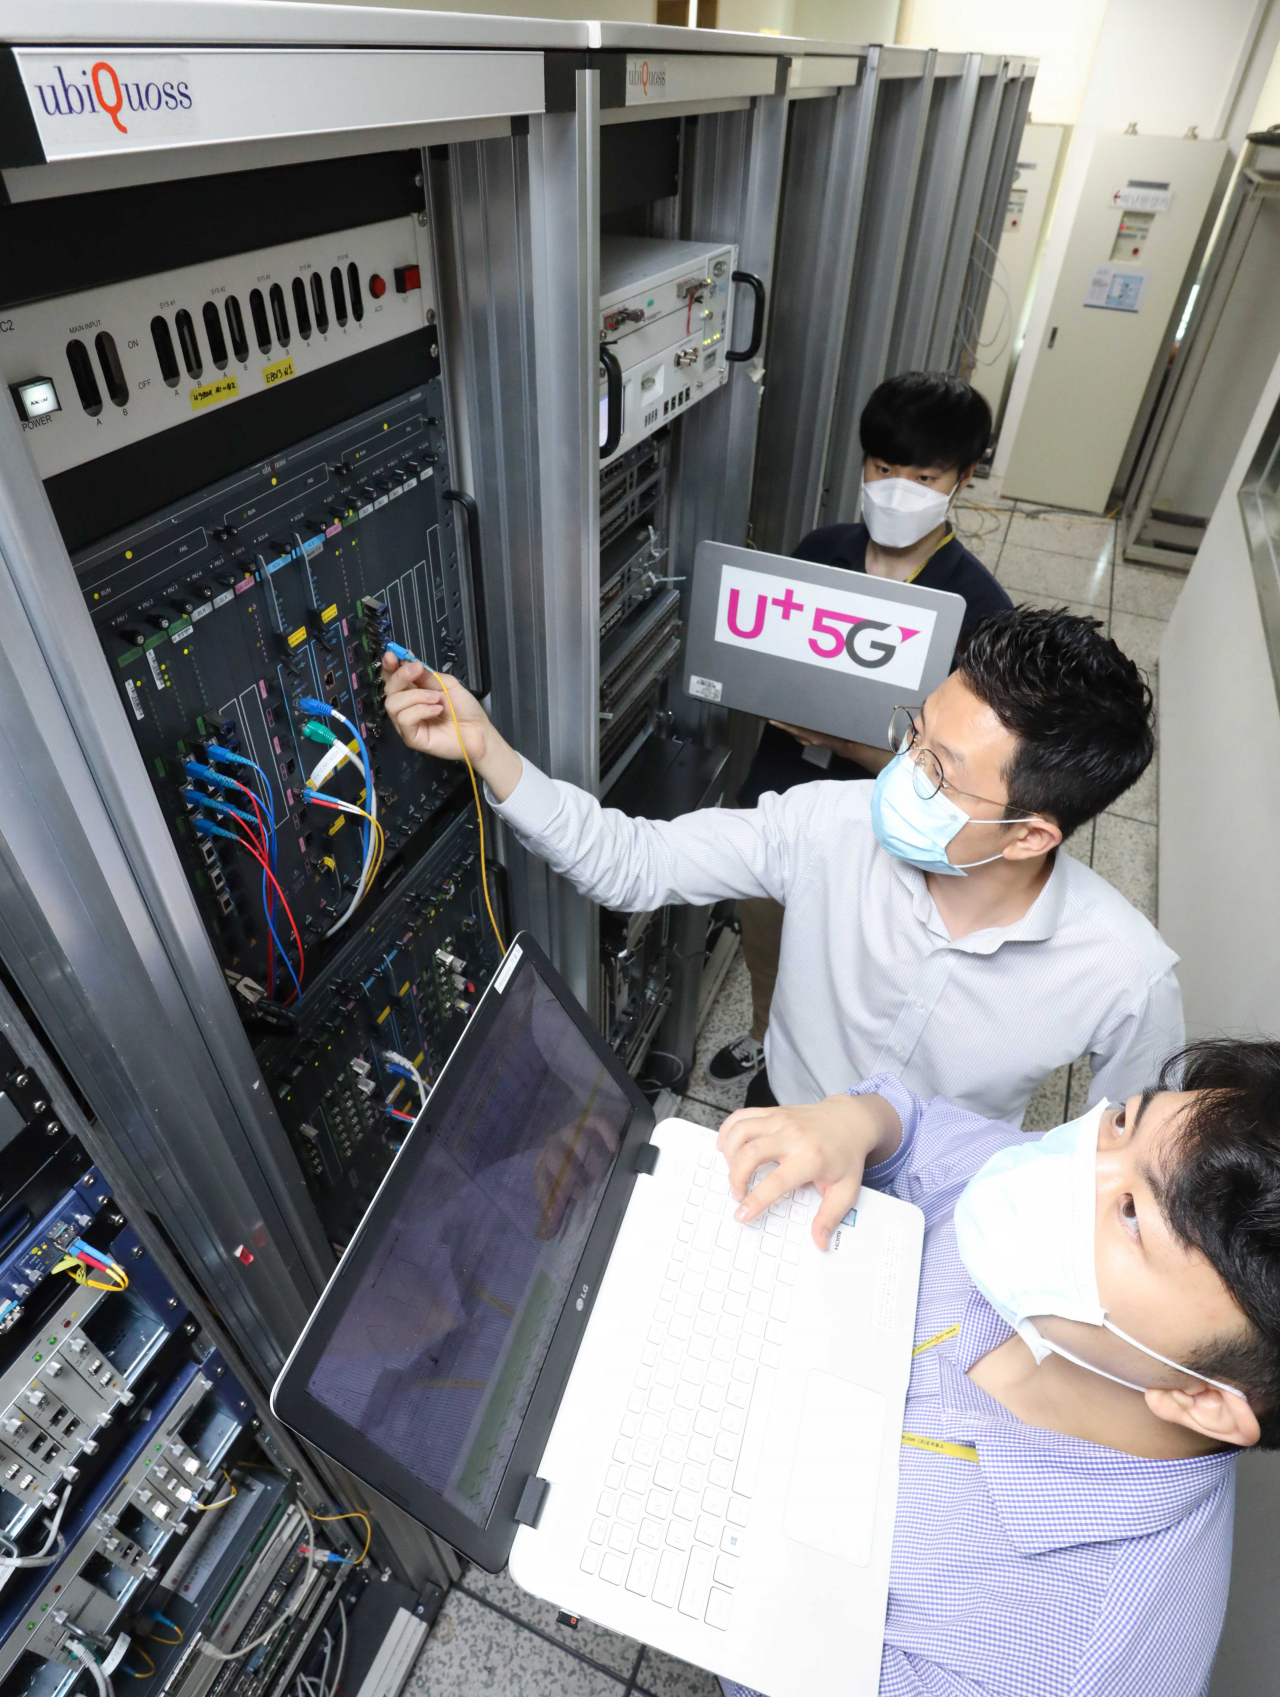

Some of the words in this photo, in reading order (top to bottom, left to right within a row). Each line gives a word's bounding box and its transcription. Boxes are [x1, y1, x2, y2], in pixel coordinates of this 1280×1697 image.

[628, 61, 666, 96] ubiQuoss
[33, 61, 194, 134] ubiQuoss
[159, 302, 170, 310] SYS
[68, 324, 84, 334] MAIN
[85, 320, 102, 330] INPUT
[128, 339, 138, 349] ON
[138, 378, 152, 390] OFF
[122, 408, 128, 416] B
[22, 414, 53, 432] POWER
[96, 418, 102, 426] A
[100, 587, 112, 597] RUN
[197, 608, 206, 616] BLK
[727, 588, 804, 639] U+
[808, 607, 898, 669] 5G
[580, 1284, 589, 1299] LG
